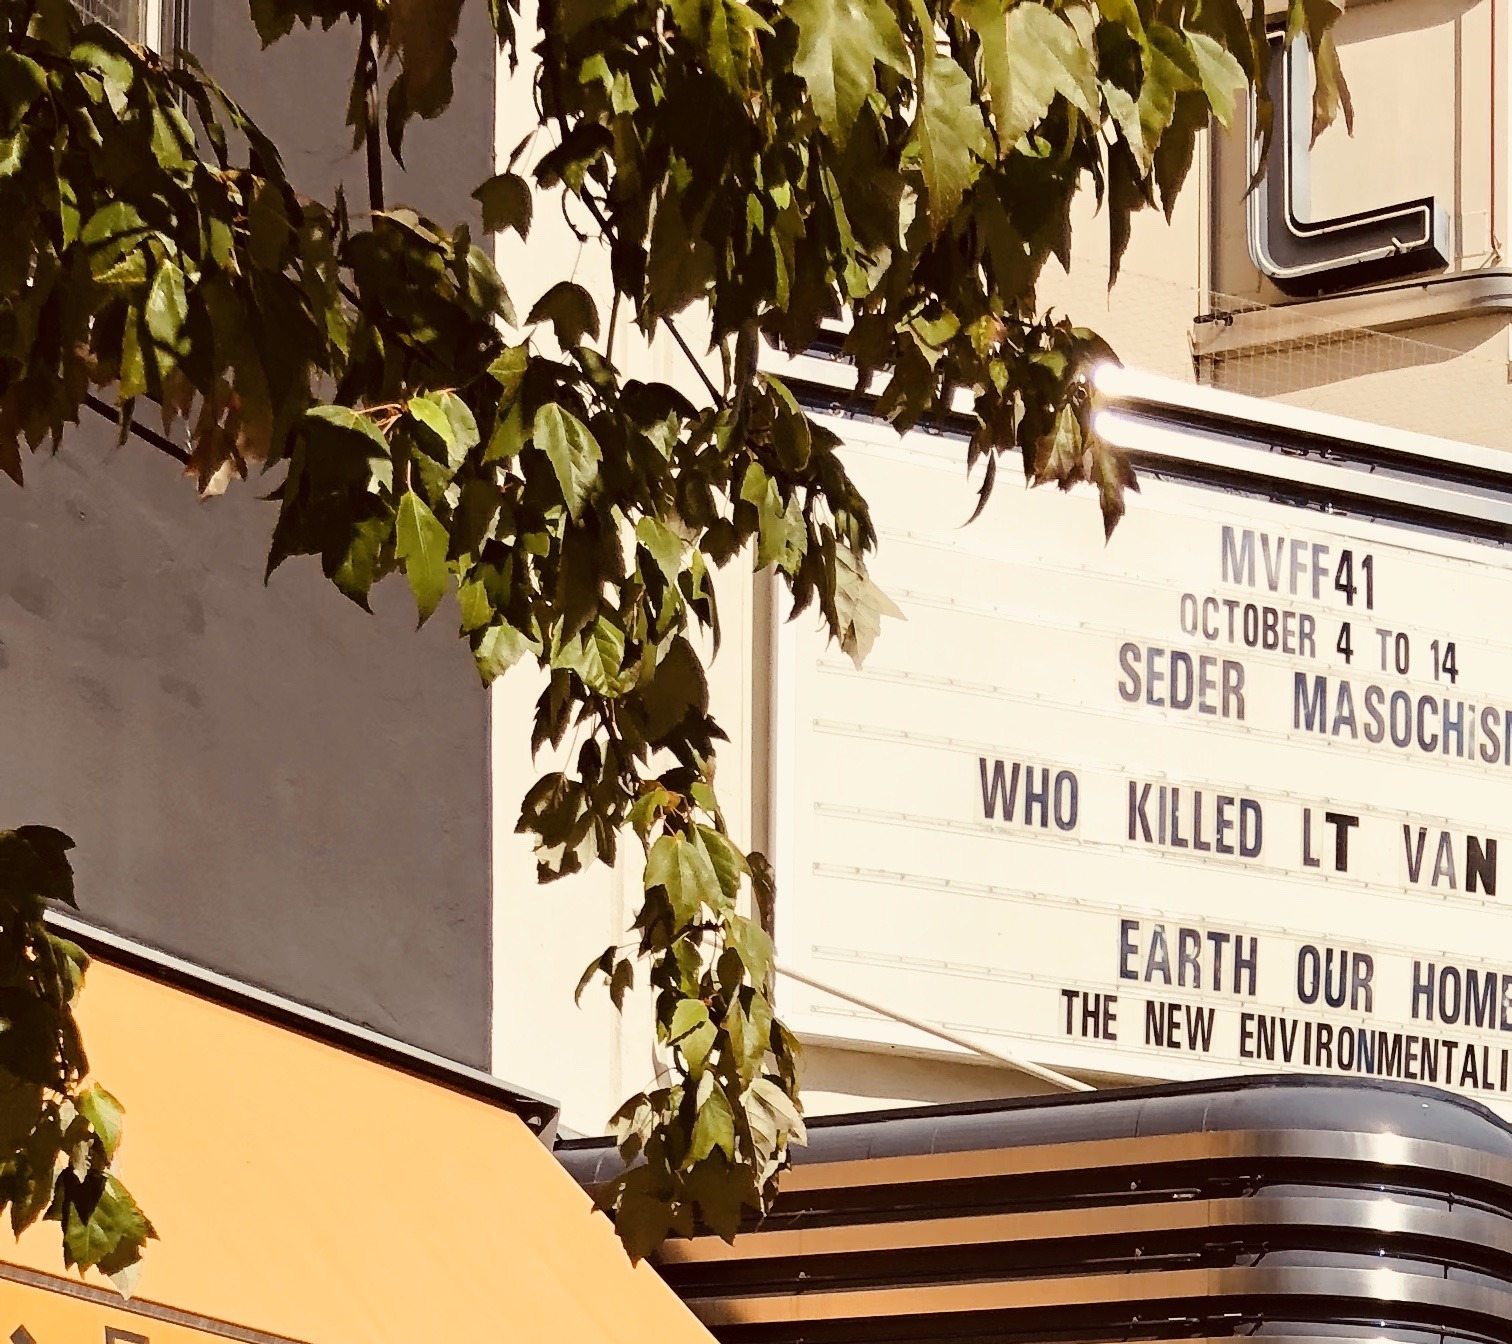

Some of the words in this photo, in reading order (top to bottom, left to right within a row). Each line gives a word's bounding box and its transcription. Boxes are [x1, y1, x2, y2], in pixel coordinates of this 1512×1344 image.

[1221, 525, 1374, 610] MVFF41
[1118, 642, 1246, 721] SEDER
[1180, 593, 1317, 659] OCTOBER
[1336, 621, 1354, 665] 4
[1375, 628, 1410, 675] TO
[1430, 639, 1460, 684] 14
[978, 757, 1079, 831] WHO
[1128, 780, 1263, 859] KILLED
[1302, 807, 1360, 873] LT
[1402, 823, 1498, 896] VAN
[1119, 918, 1258, 996] EARTH
[1297, 944, 1374, 1013] OUR
[1061, 988, 1119, 1041] THE
[1145, 1000, 1216, 1053] NEW
